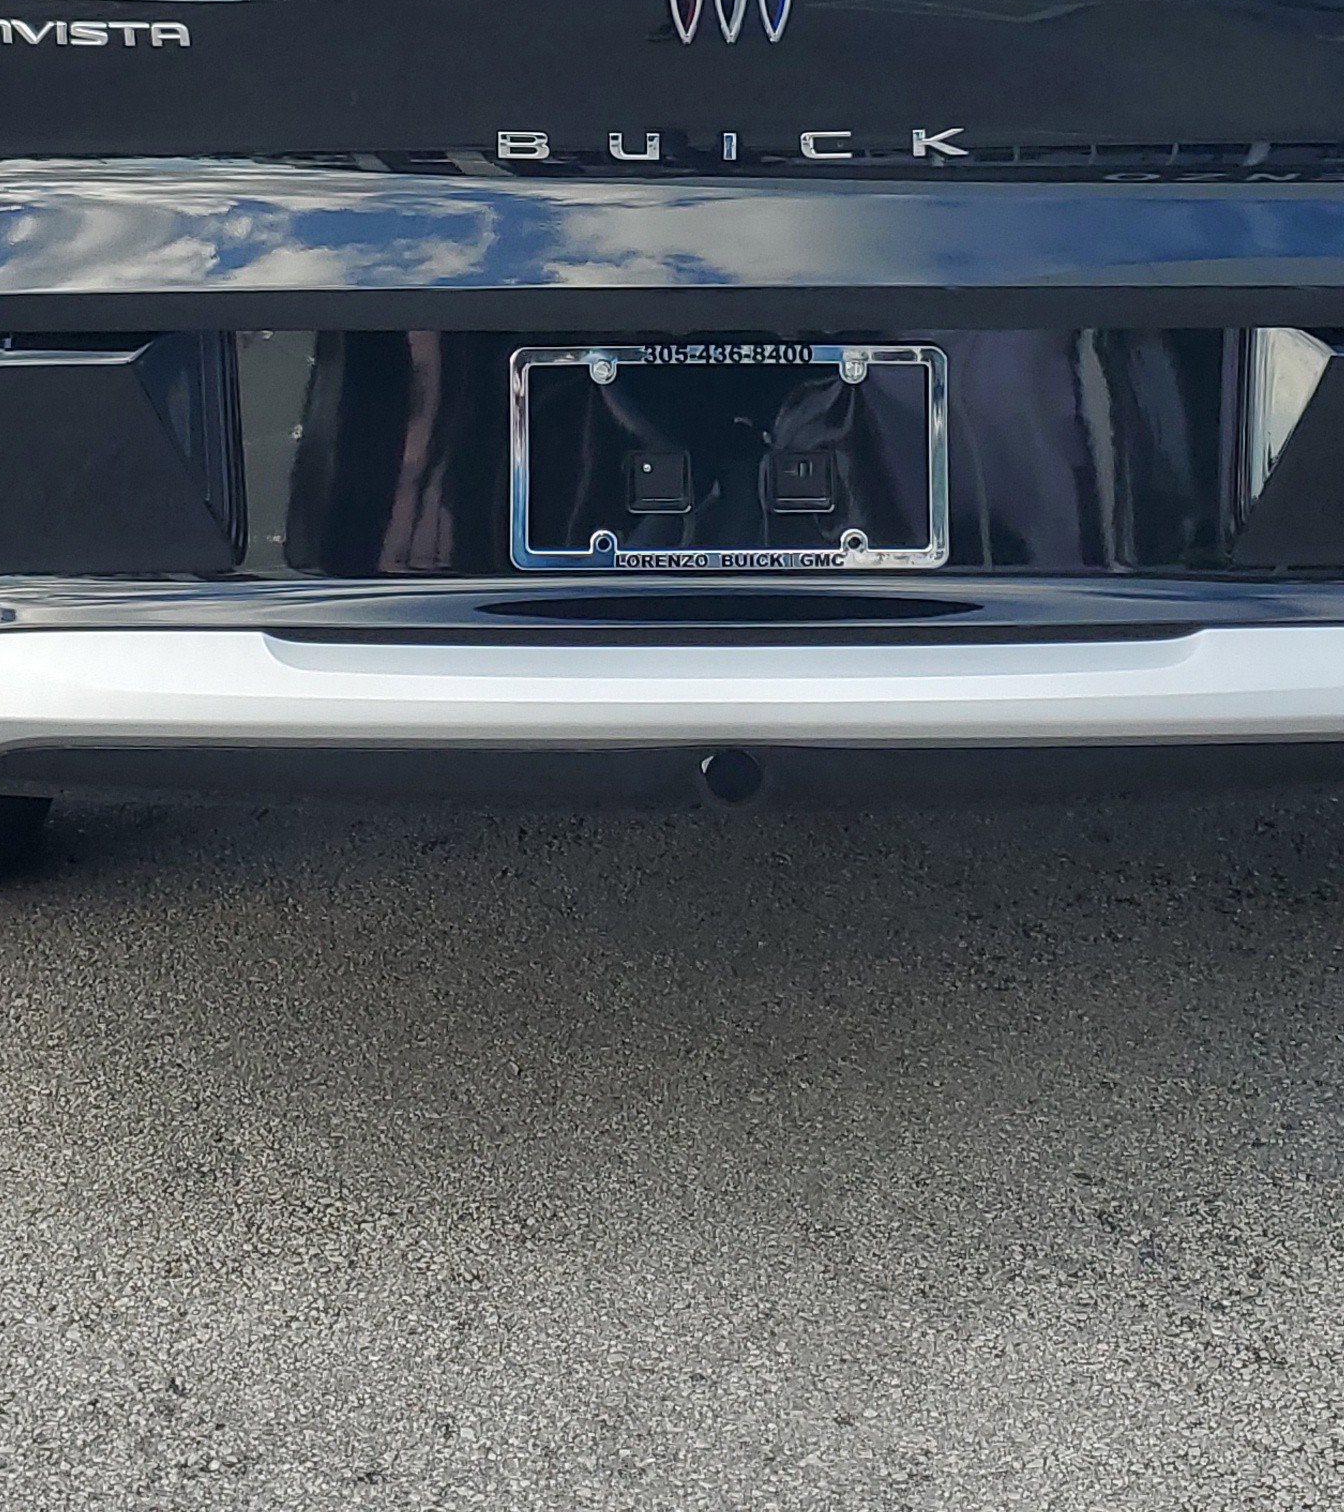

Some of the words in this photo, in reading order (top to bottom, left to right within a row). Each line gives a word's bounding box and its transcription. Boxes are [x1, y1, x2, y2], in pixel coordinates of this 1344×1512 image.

[497, 127, 970, 161] BUICK
[643, 344, 814, 364] 305-436-8400
[614, 553, 709, 568] LORENZO
[721, 553, 785, 568] BUICK
[799, 553, 846, 568] GMC
